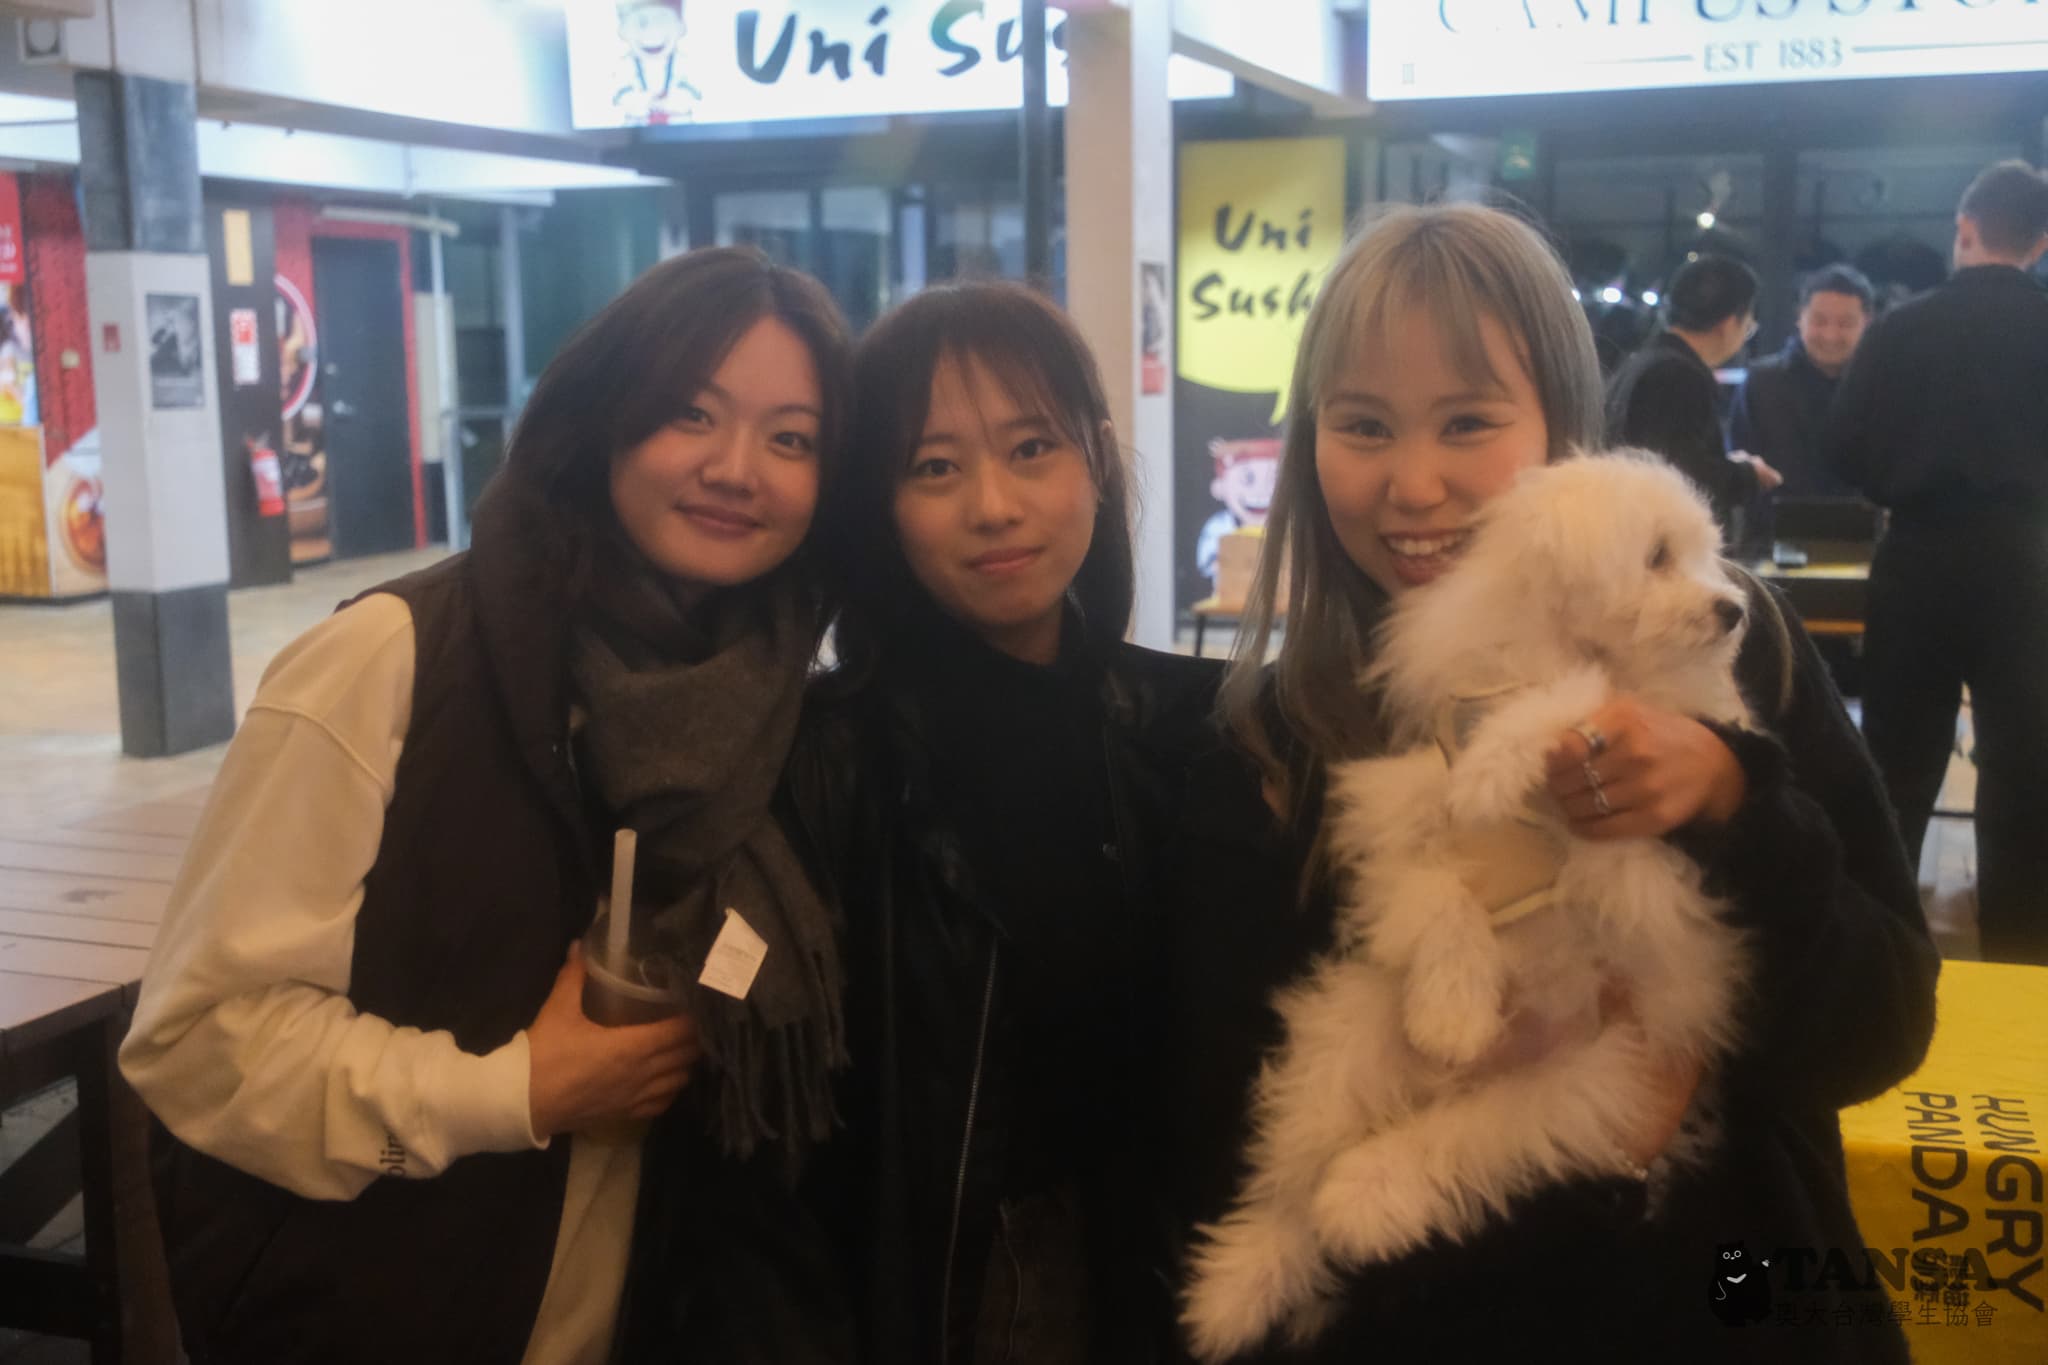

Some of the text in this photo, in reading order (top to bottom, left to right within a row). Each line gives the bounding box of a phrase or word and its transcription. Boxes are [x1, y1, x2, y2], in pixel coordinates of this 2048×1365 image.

[736, 6, 890, 84] Uni
[1703, 37, 1844, 72] EST 1883
[1213, 203, 1314, 253] Uni
[1904, 1092, 1970, 1242] PANDA
[1972, 1094, 2044, 1313] HUNGRY
